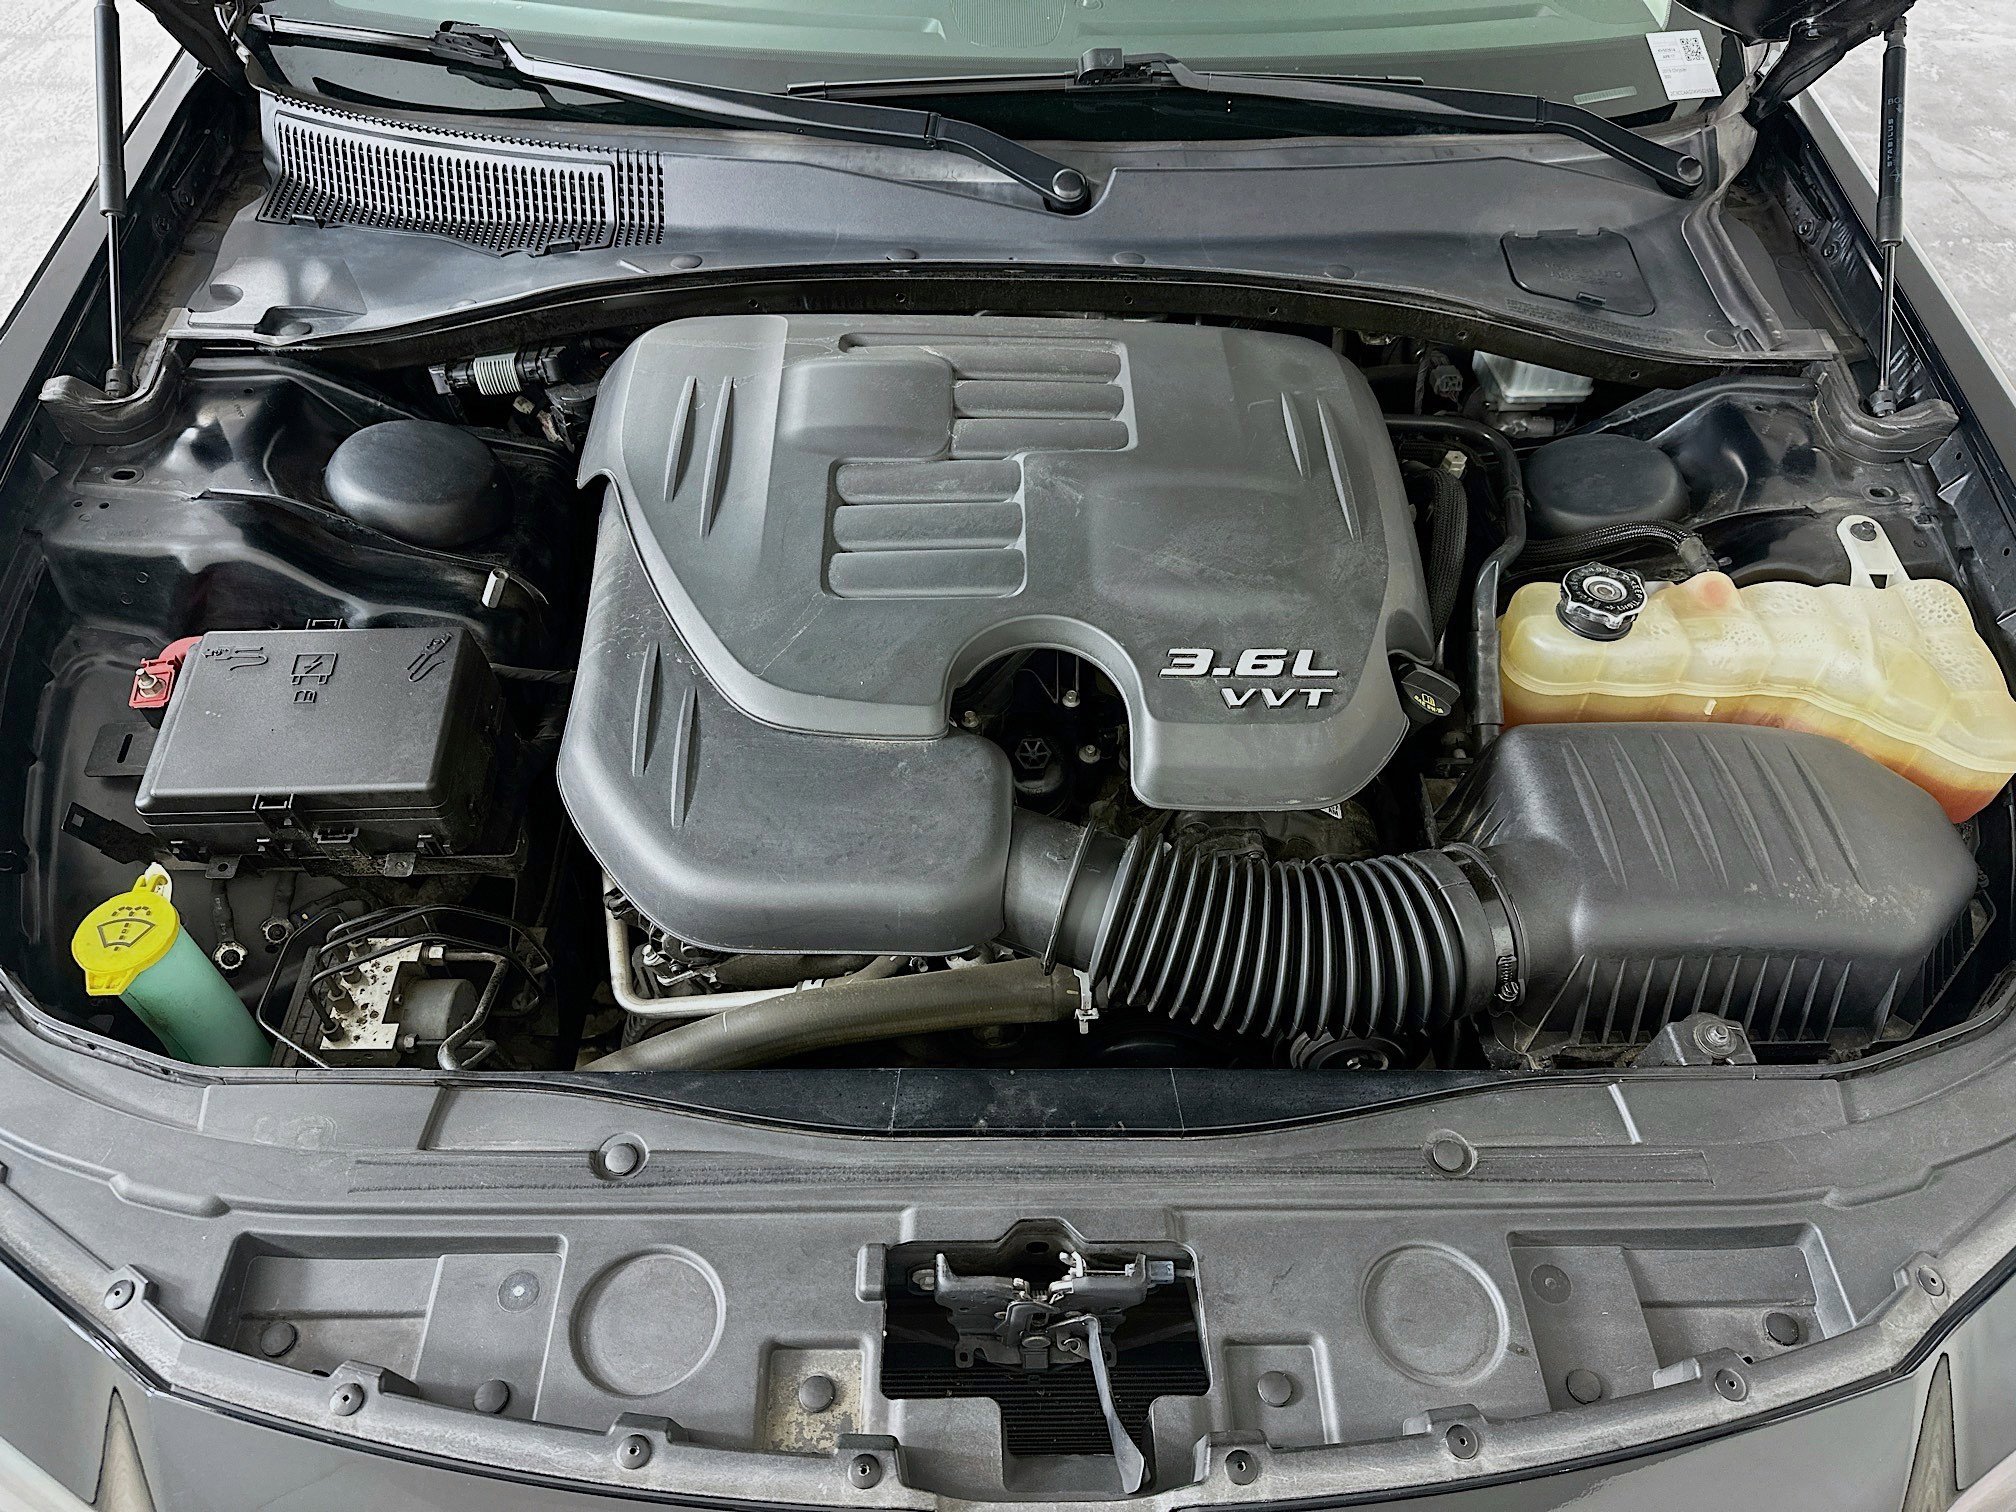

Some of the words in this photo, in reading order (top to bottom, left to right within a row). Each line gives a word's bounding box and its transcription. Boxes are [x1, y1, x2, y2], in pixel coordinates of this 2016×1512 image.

[1886, 118, 1894, 167] STABILUS
[1630, 580, 1643, 599] KEEP
[1616, 600, 1641, 611] TIGHT
[1159, 648, 1339, 678] 3.6L
[1220, 687, 1334, 710] VVT
